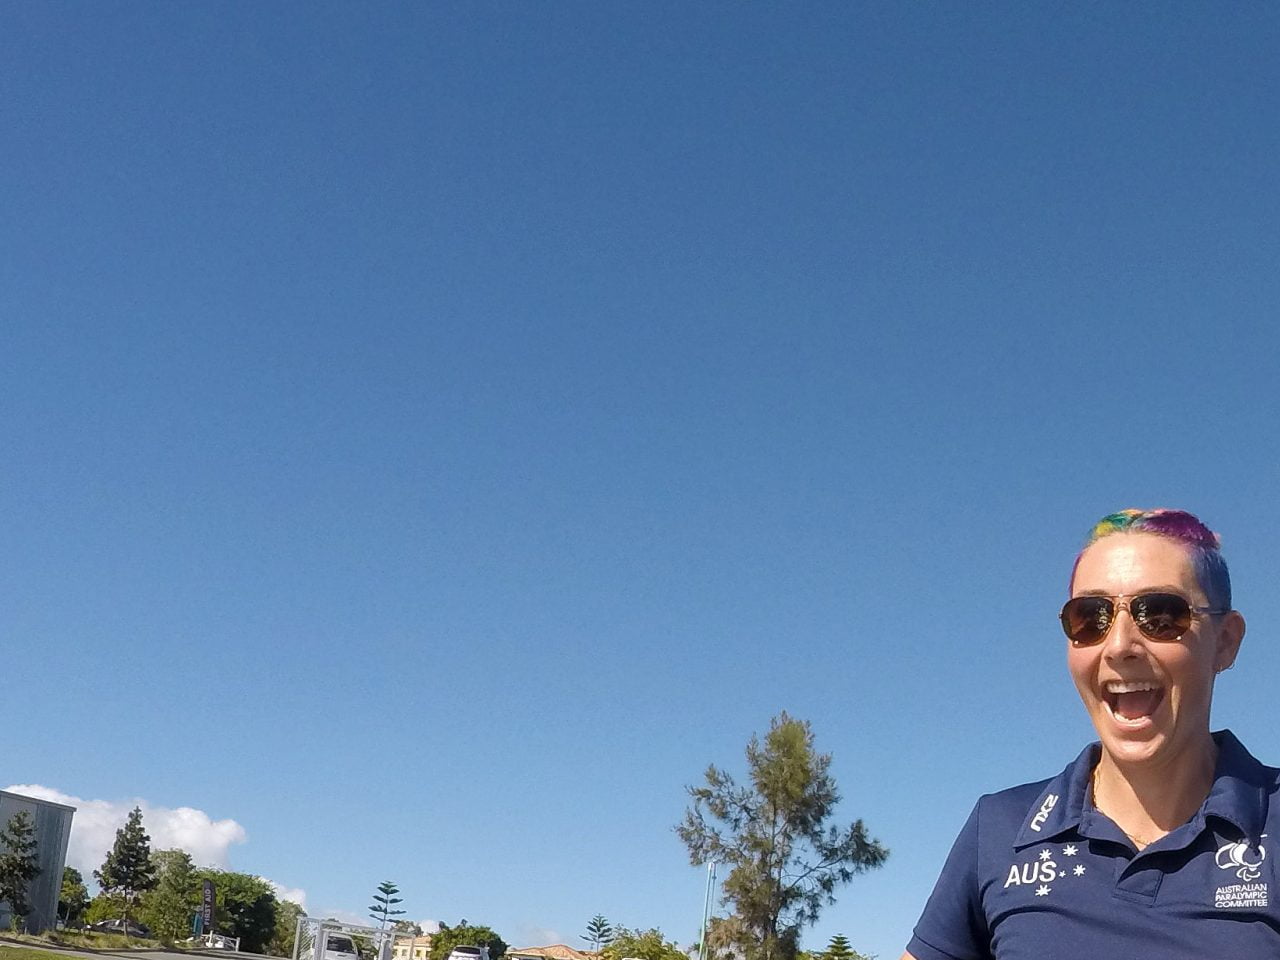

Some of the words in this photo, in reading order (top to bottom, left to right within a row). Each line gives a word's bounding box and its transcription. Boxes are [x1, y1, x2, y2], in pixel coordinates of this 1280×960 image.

[1030, 794, 1059, 832] 2XU
[1003, 861, 1057, 888] AUS
[1215, 883, 1268, 894] AUSTRALIAN
[1215, 891, 1268, 901] PARALYMPIC
[1214, 899, 1268, 908] COMMITTEE
[203, 903, 211, 926] FIRST
